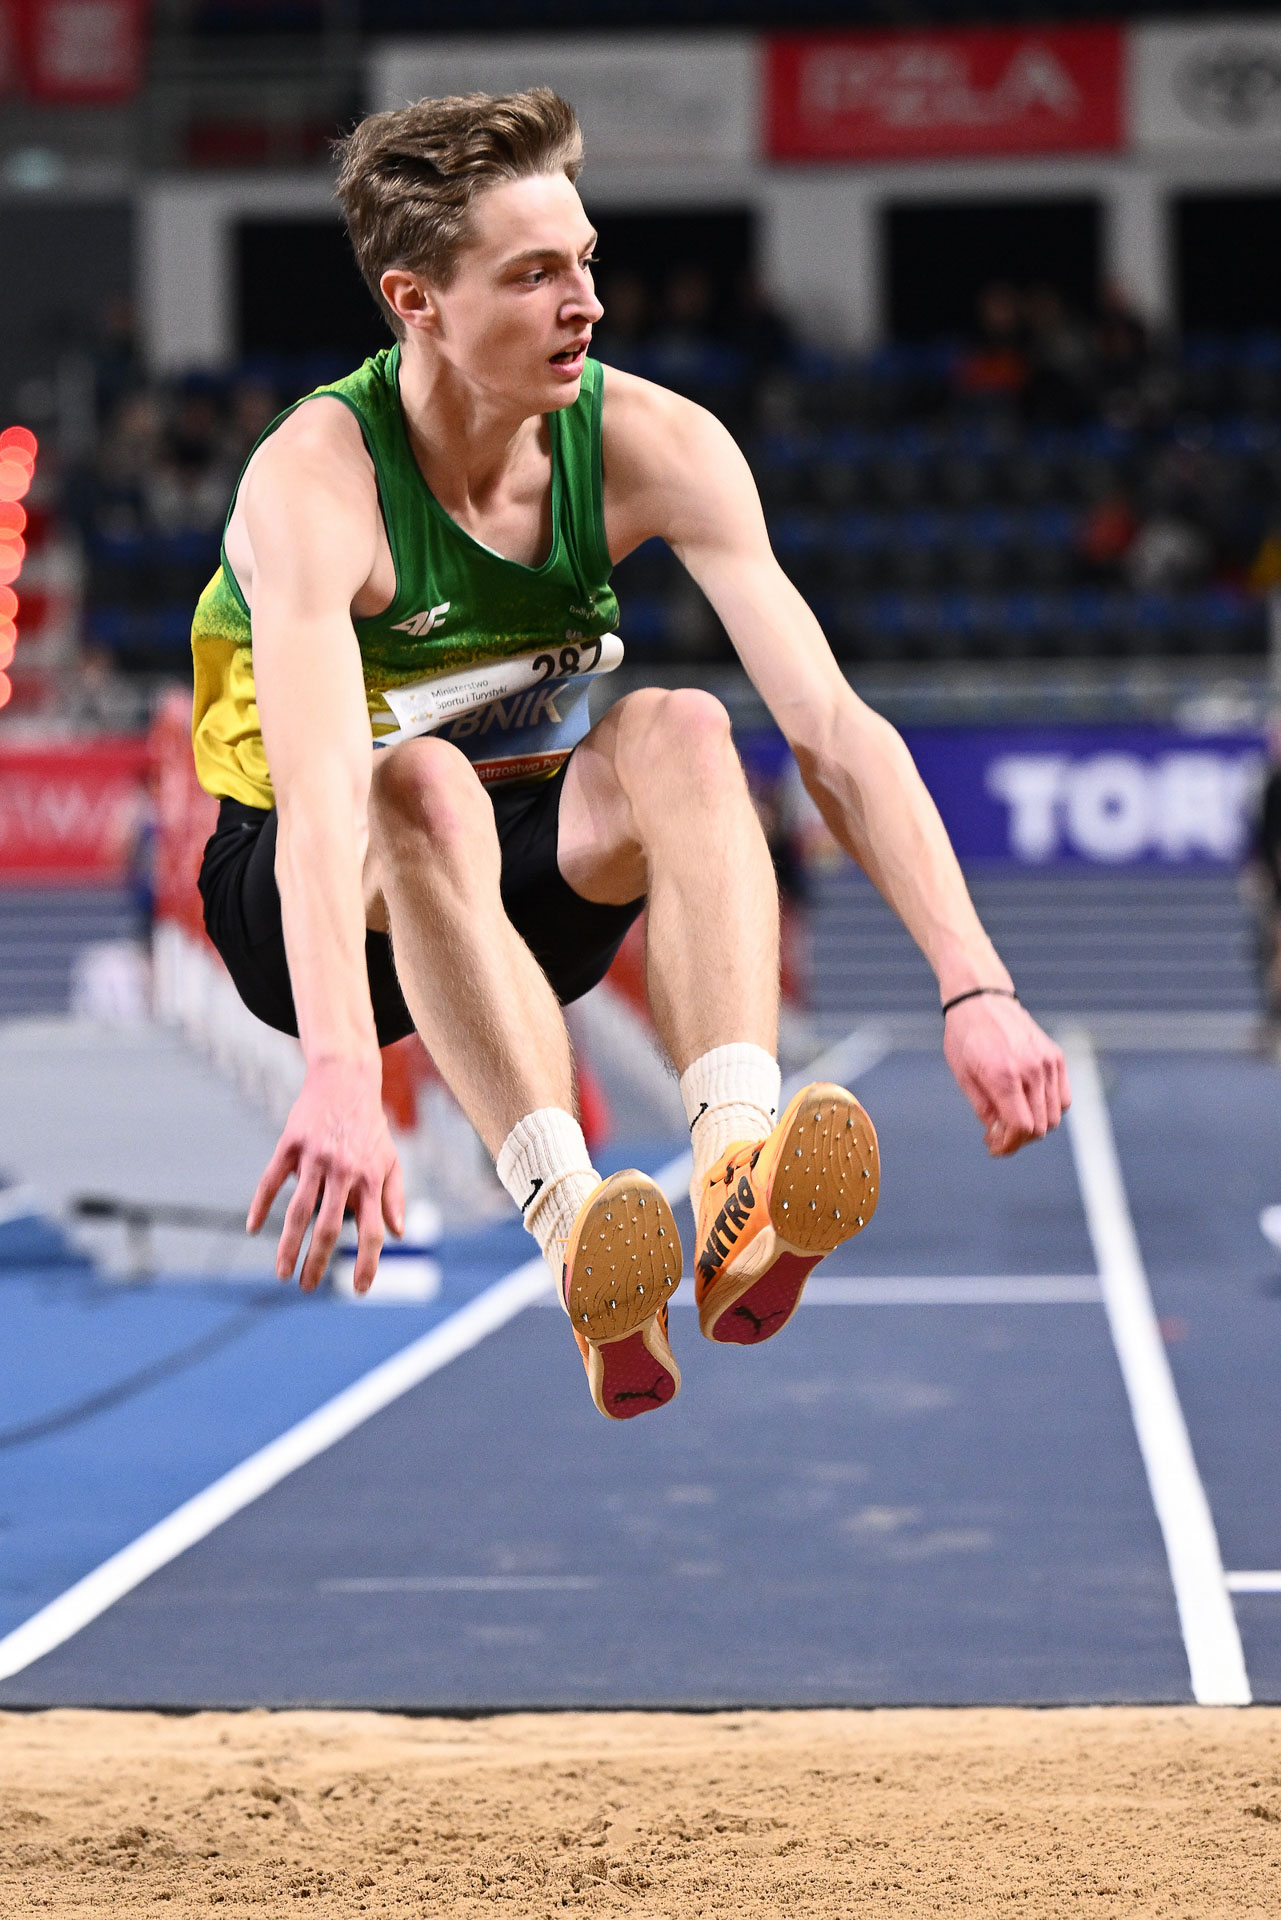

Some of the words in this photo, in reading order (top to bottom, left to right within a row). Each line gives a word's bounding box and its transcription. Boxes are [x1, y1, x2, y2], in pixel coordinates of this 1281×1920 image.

[532, 636, 602, 684] 287
[430, 683, 569, 738] BNIK
[431, 680, 489, 698] Ministerstwo
[435, 697, 465, 710] Sportu
[472, 685, 508, 701] Turystyki
[698, 1176, 755, 1289] NITRO
